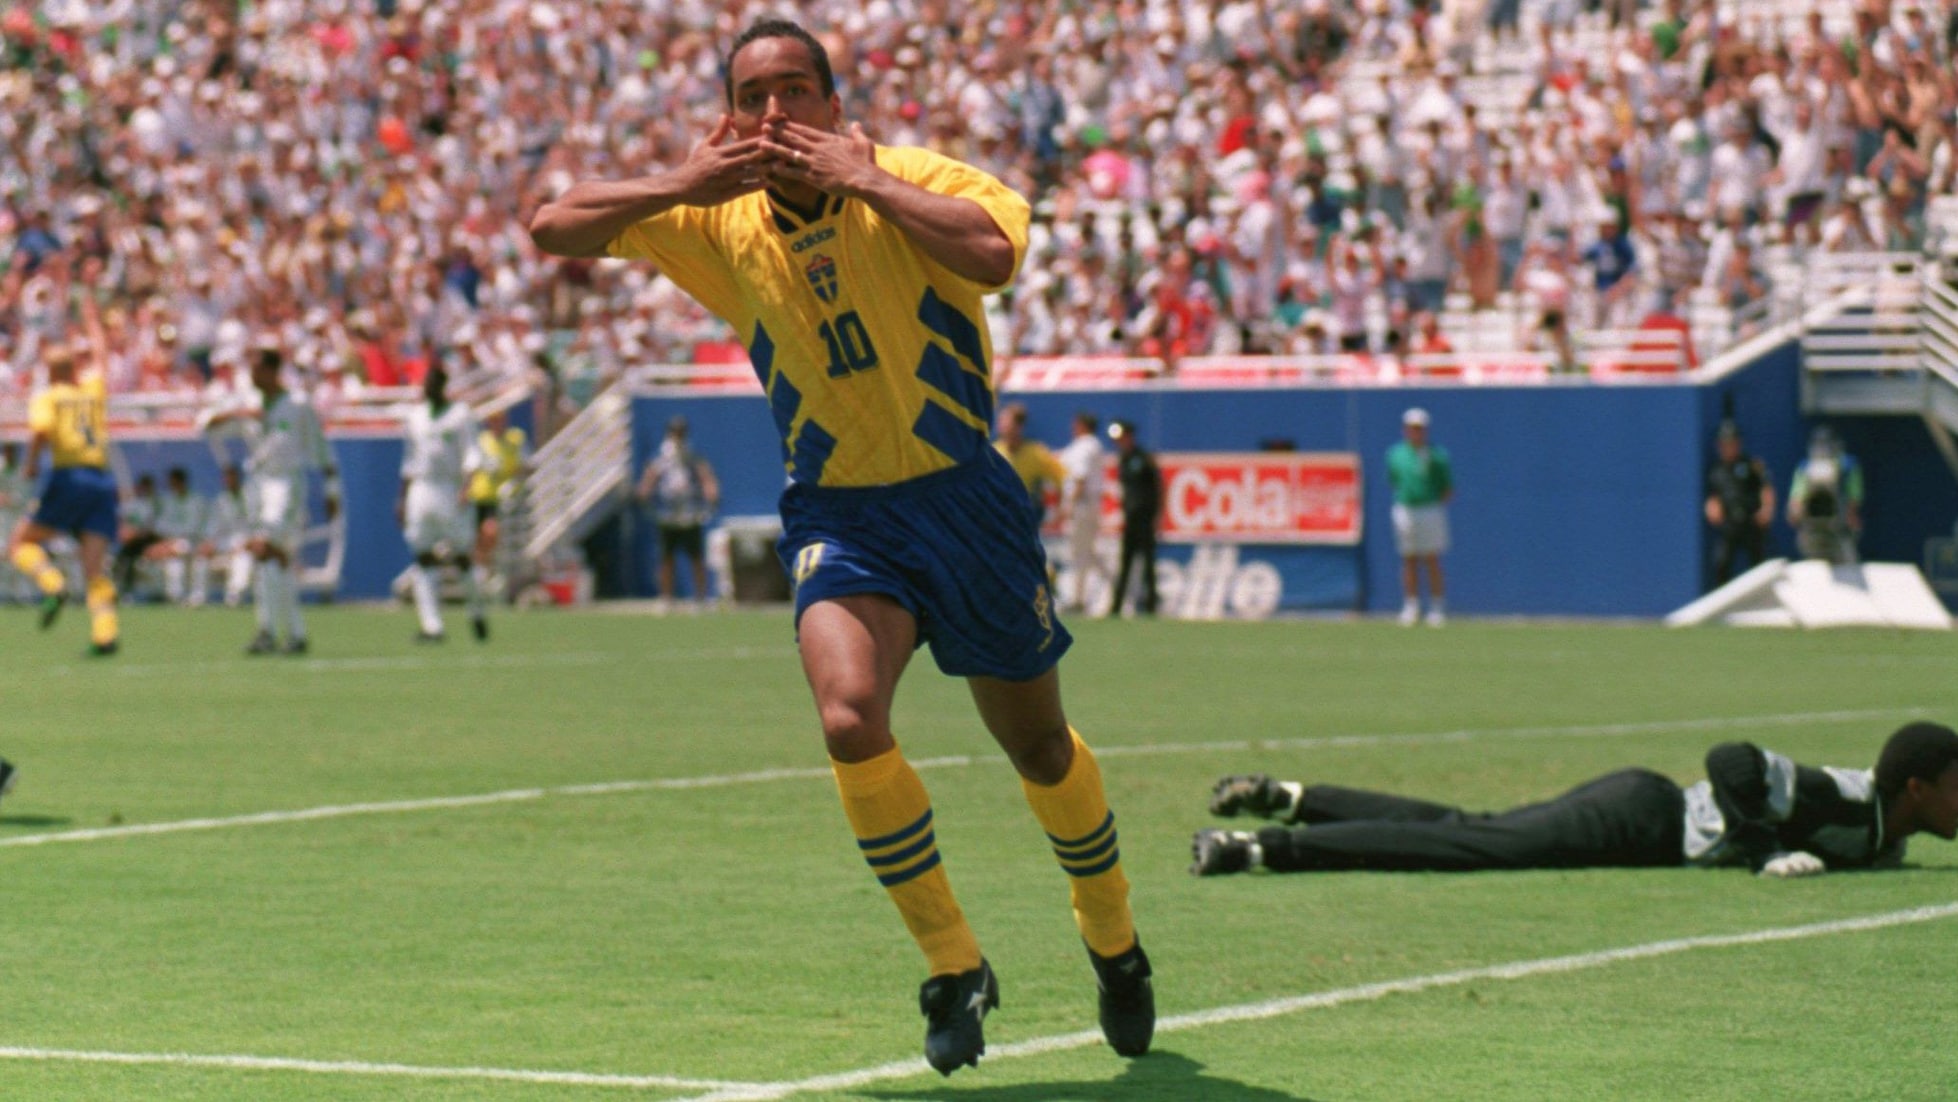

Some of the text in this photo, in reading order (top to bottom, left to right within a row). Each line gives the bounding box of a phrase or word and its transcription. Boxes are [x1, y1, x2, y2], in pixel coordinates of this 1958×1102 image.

[791, 226, 836, 253] adidas
[818, 310, 879, 379] 10
[1166, 465, 1290, 529] Cola
